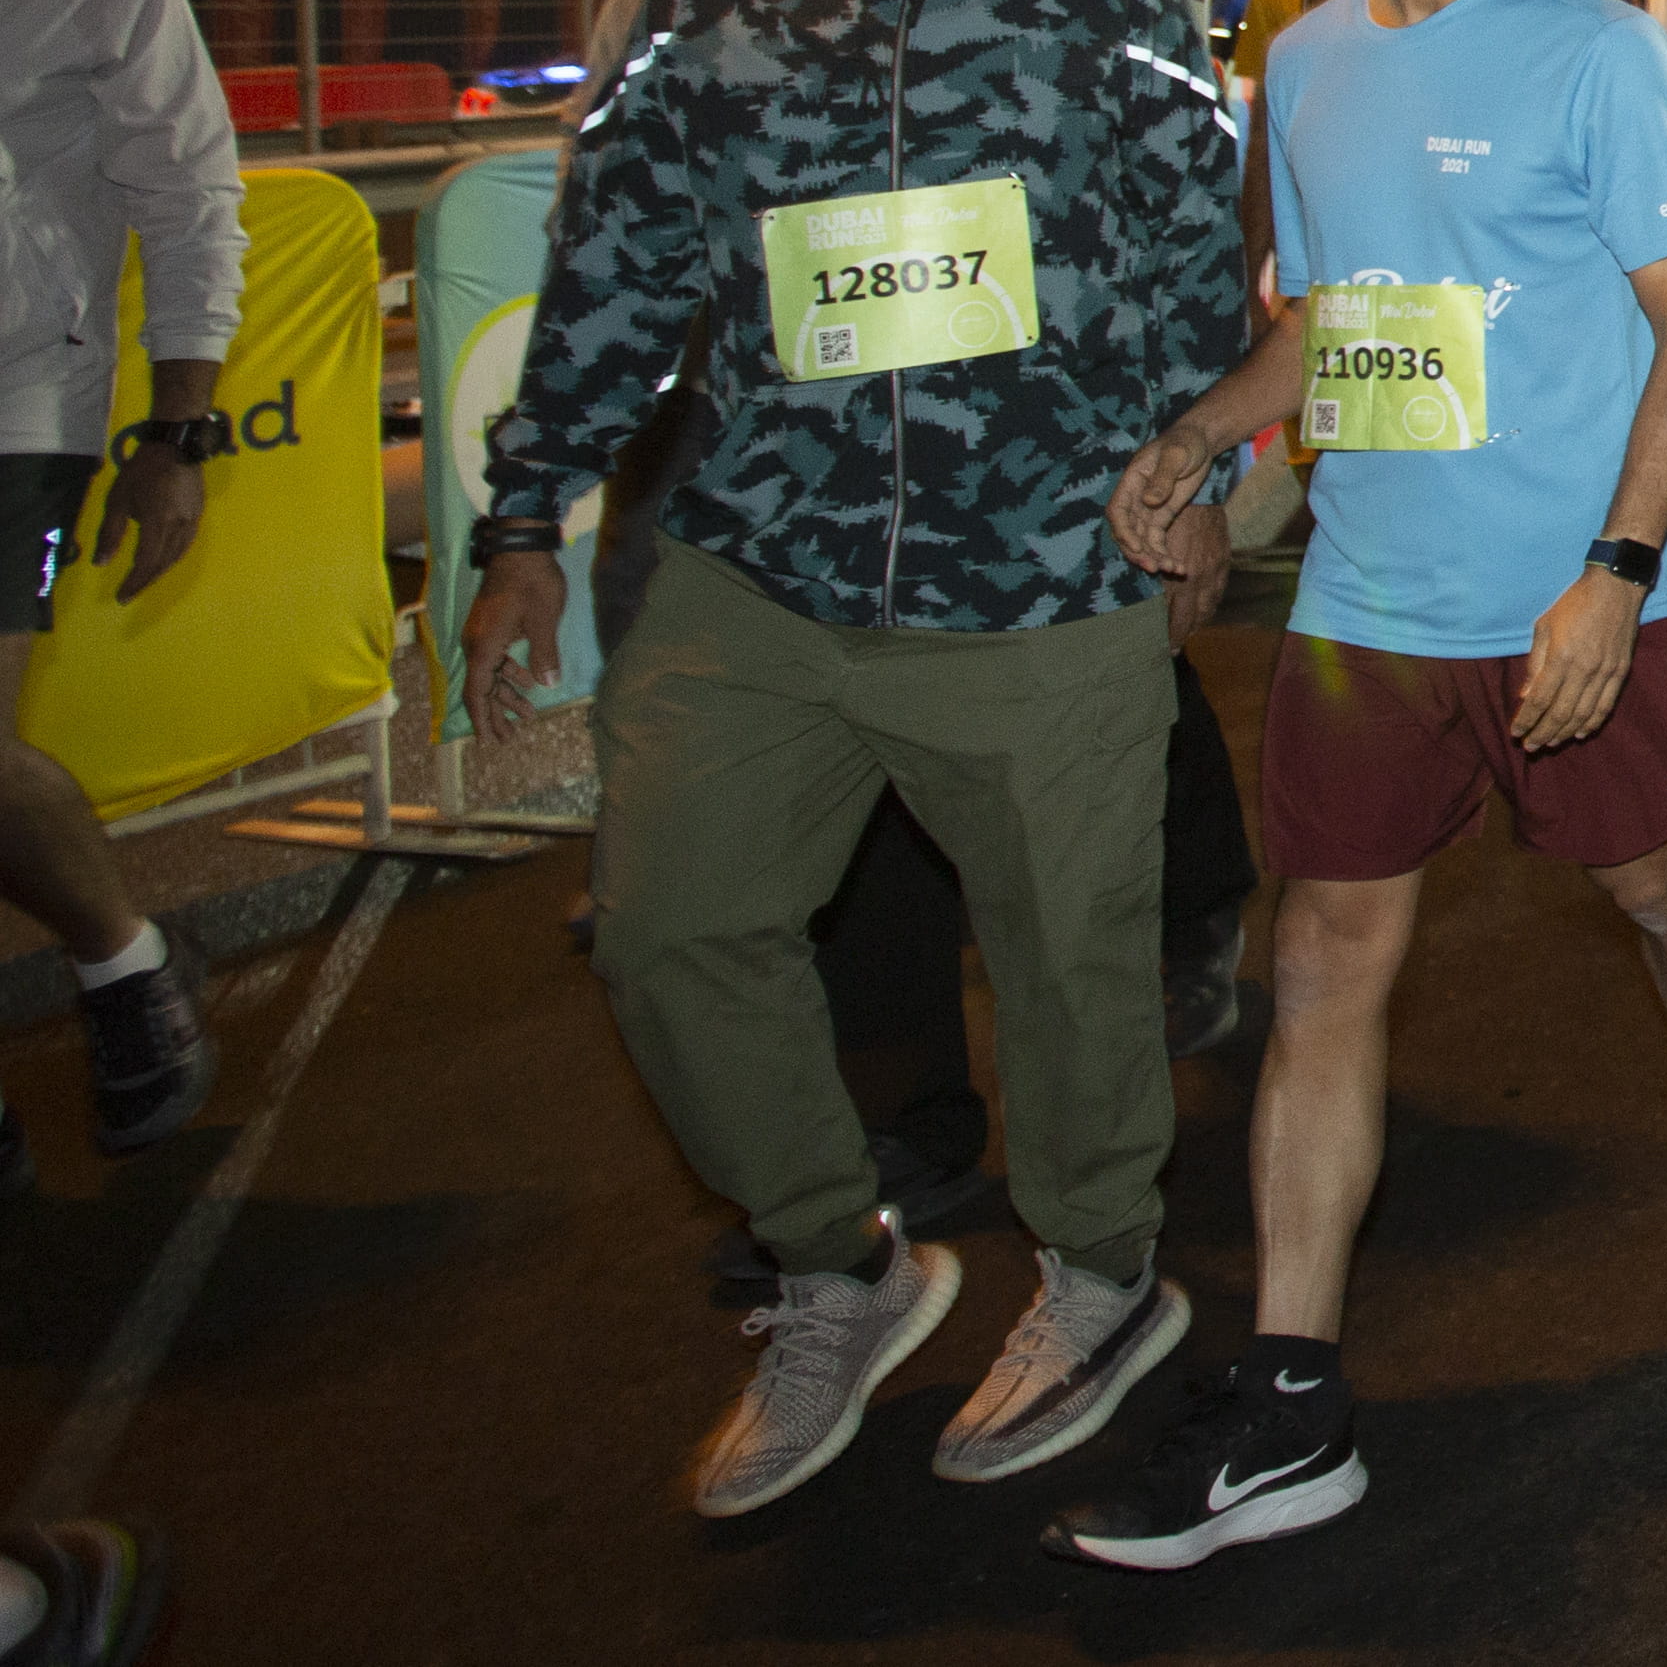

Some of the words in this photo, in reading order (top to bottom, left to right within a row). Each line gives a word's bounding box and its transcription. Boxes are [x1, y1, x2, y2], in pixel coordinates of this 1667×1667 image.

[1426, 136, 1463, 153] DUBAI
[1464, 139, 1492, 156] RUN
[1440, 157, 1470, 174] 2021
[806, 206, 885, 234] DUBAI
[808, 229, 855, 251] RUN
[812, 249, 988, 306] 128037
[1317, 293, 1369, 313] DUBAI
[1317, 312, 1345, 329] RUN
[1316, 346, 1445, 381] 110936
